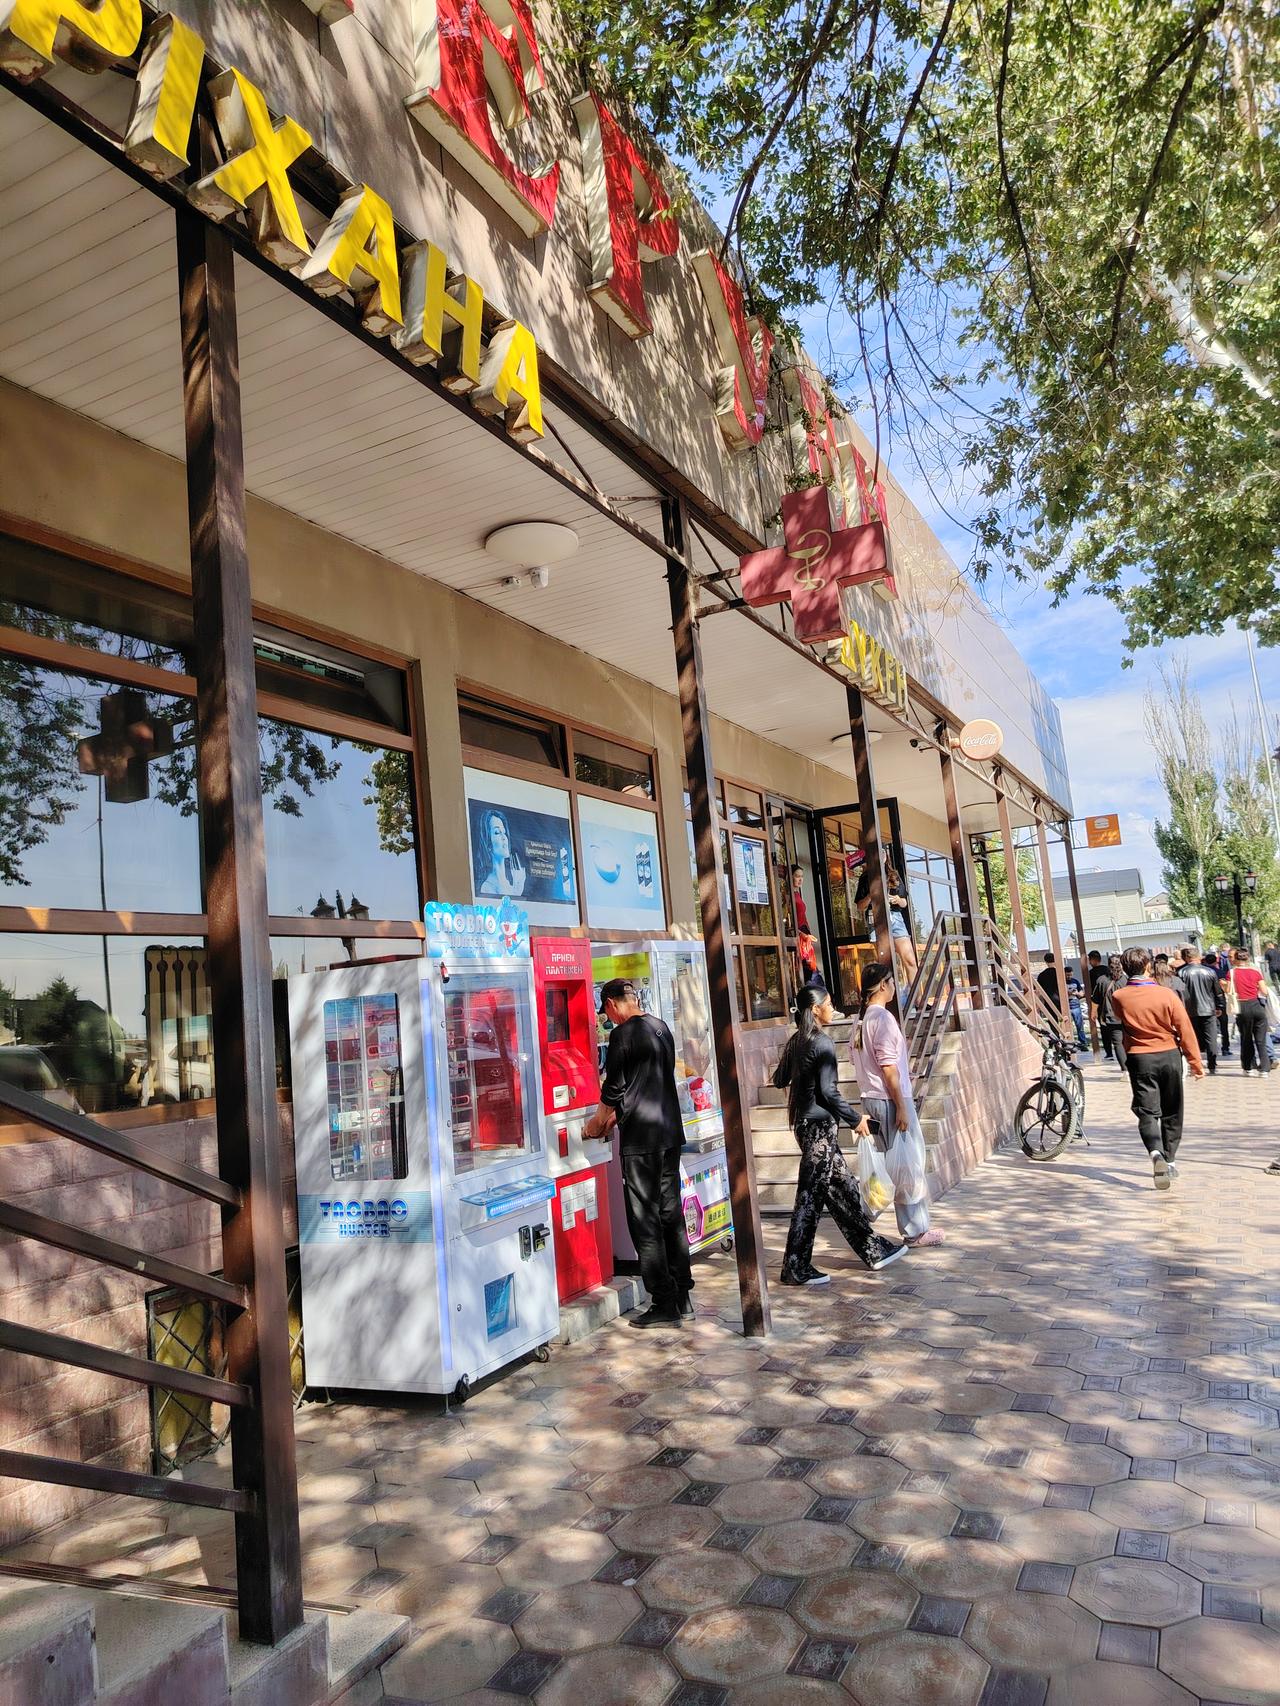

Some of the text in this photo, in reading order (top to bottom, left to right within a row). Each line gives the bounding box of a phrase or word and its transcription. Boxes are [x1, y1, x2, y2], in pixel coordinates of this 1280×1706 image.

[431, 911, 497, 934] TAOBAO
[319, 1197, 409, 1222] TAOBAO
[338, 1222, 391, 1239] HUNTER
